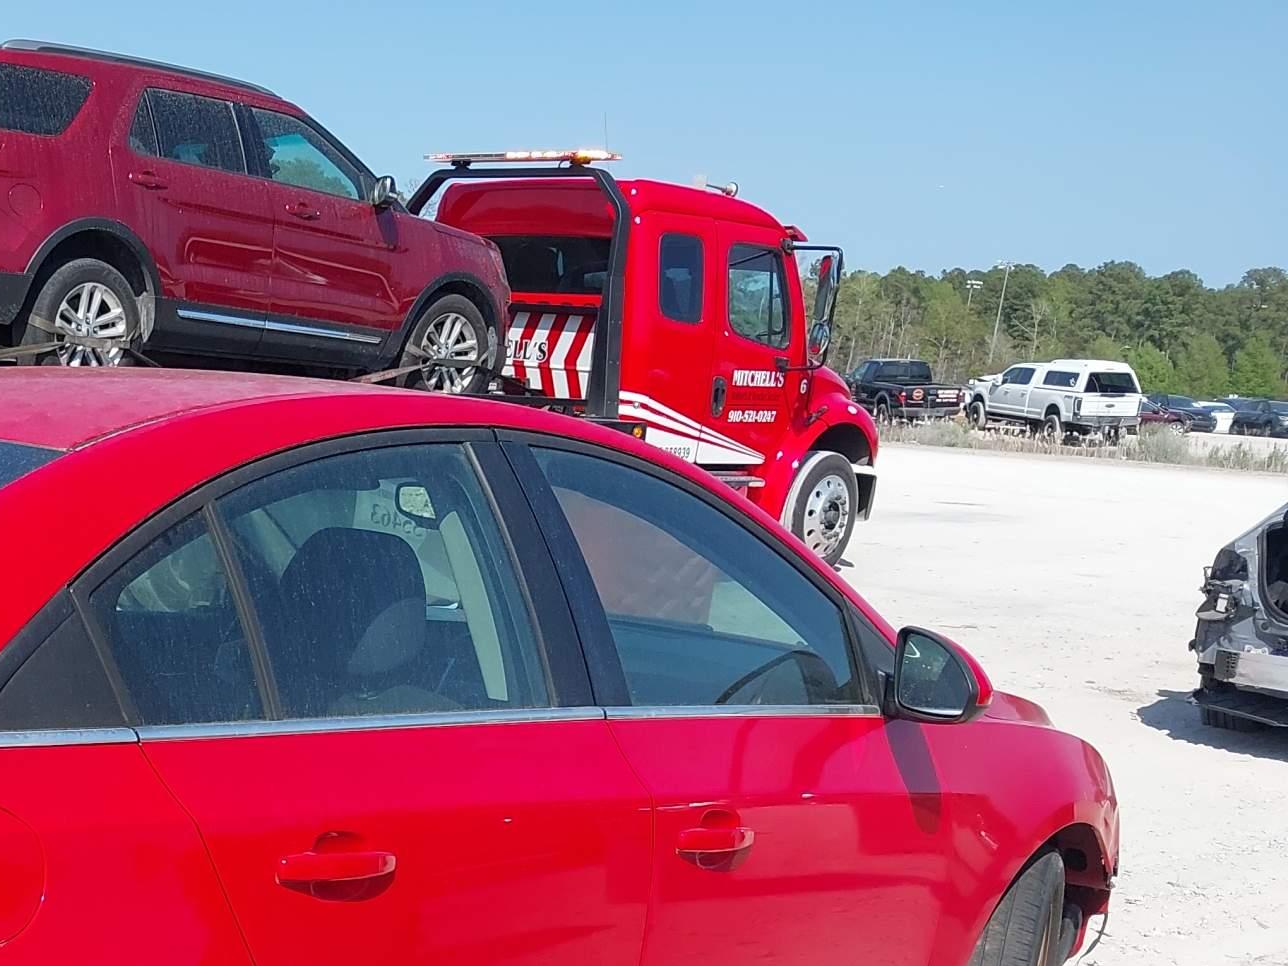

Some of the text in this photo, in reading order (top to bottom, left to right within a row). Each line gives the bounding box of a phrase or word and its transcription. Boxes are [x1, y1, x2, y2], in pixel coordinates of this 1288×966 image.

[732, 369, 785, 388] MITCHELL'S
[800, 379, 809, 394] 6
[727, 409, 777, 423] 910-521-0247
